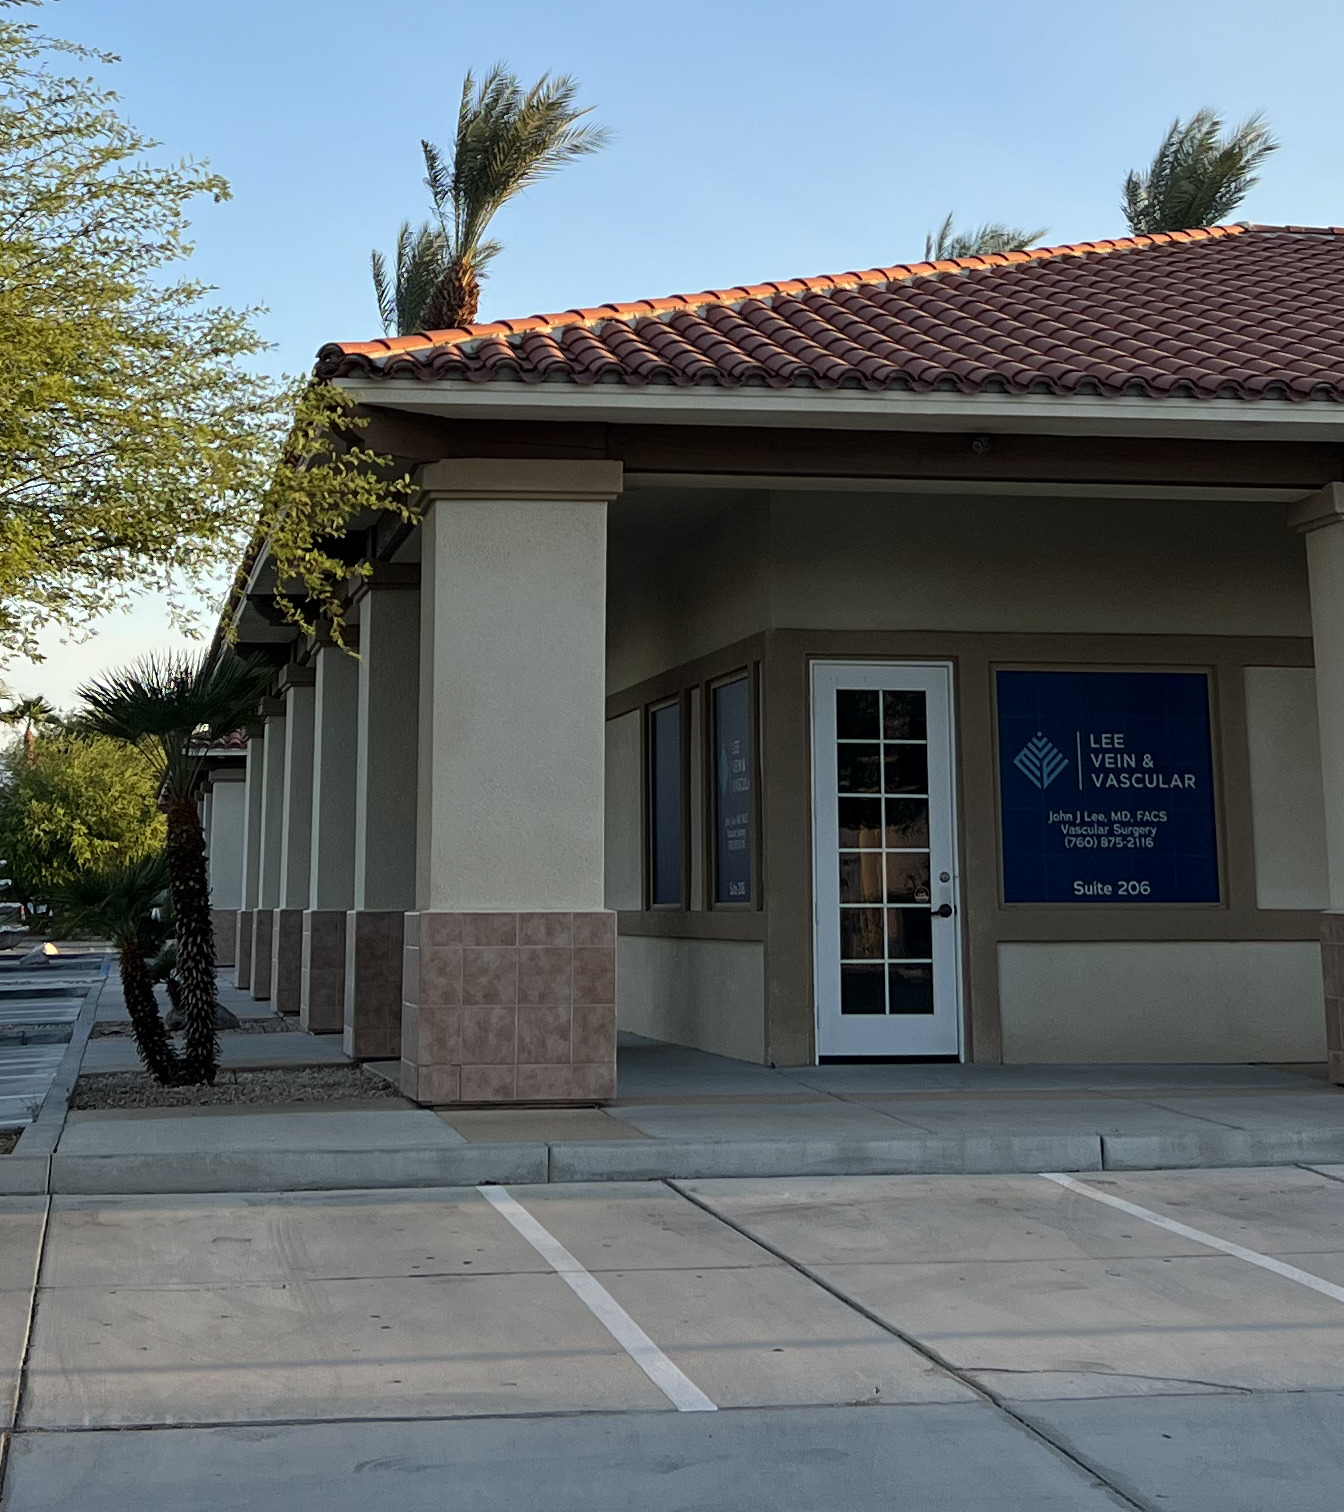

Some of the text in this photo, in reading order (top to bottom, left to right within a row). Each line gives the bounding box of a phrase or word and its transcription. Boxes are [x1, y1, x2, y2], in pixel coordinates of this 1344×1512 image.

[1090, 734, 1124, 748] LEE
[1090, 754, 1153, 768] VEIN &
[1092, 773, 1196, 789] VASCULAR
[1048, 810, 1073, 825] John
[1075, 811, 1081, 824] J
[1137, 811, 1167, 822] FACS
[1061, 823, 1157, 838] Vascular Surgery
[1065, 836, 1154, 848] (760) 875-2116
[1074, 881, 1150, 895] Suite 206
